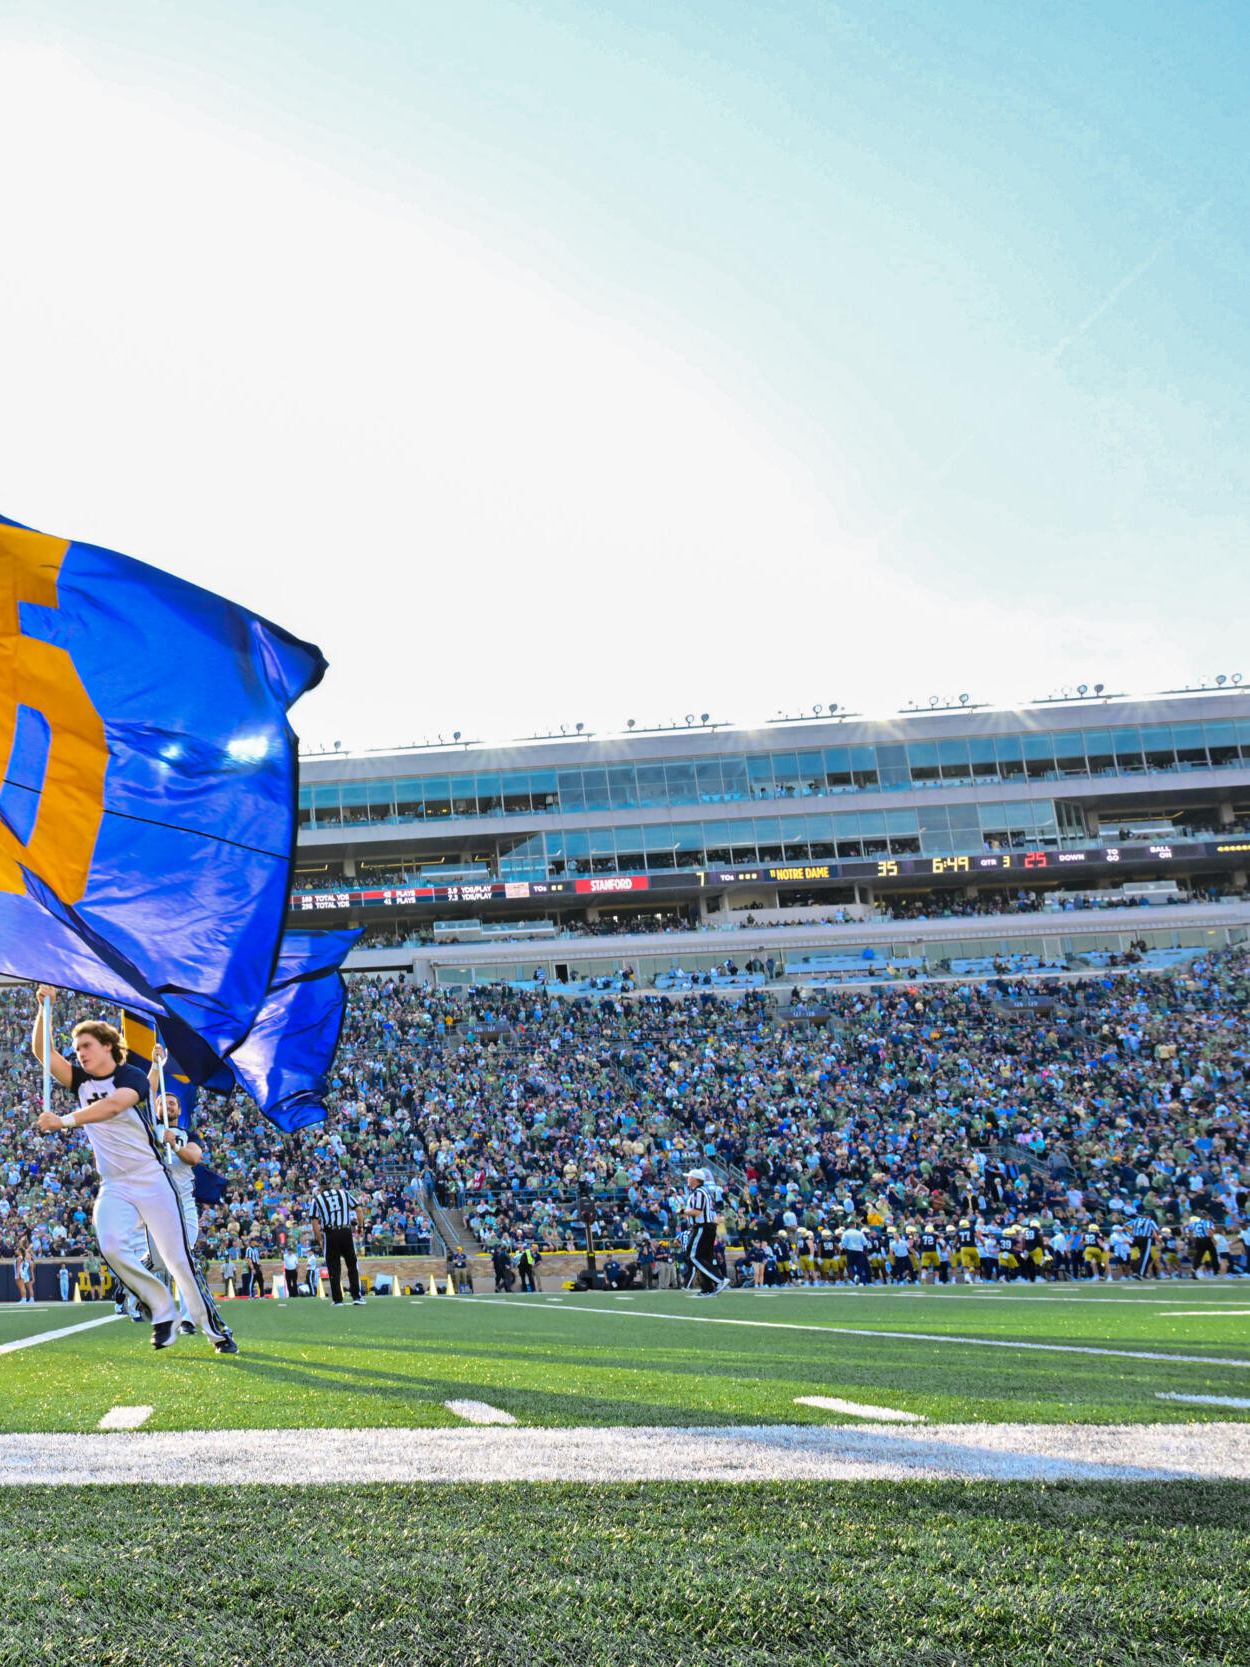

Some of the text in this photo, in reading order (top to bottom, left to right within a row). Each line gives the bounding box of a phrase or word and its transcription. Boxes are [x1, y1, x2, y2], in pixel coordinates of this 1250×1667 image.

[1002, 855, 1011, 868] 3
[1024, 852, 1047, 868] 25
[1059, 854, 1085, 862] DOWN
[877, 861, 898, 877] 35
[932, 856, 970, 873] 6:49
[776, 868, 805, 881] NOTRE
[805, 866, 830, 879] DAME
[696, 872, 705, 887] 7
[460, 885, 492, 894] YDS/PLAY
[590, 878, 633, 892] STANFORD
[314, 894, 336, 902] TOTAL
[395, 890, 416, 898] PLAYS
[461, 892, 492, 901] YDS/PLAY
[315, 901, 336, 909] TOTAL
[396, 897, 416, 905] PLAYS
[1195, 1223, 1203, 1233] C
[922, 1235, 934, 1246] 72
[959, 1231, 971, 1242] 77
[1000, 1240, 1012, 1250] 39
